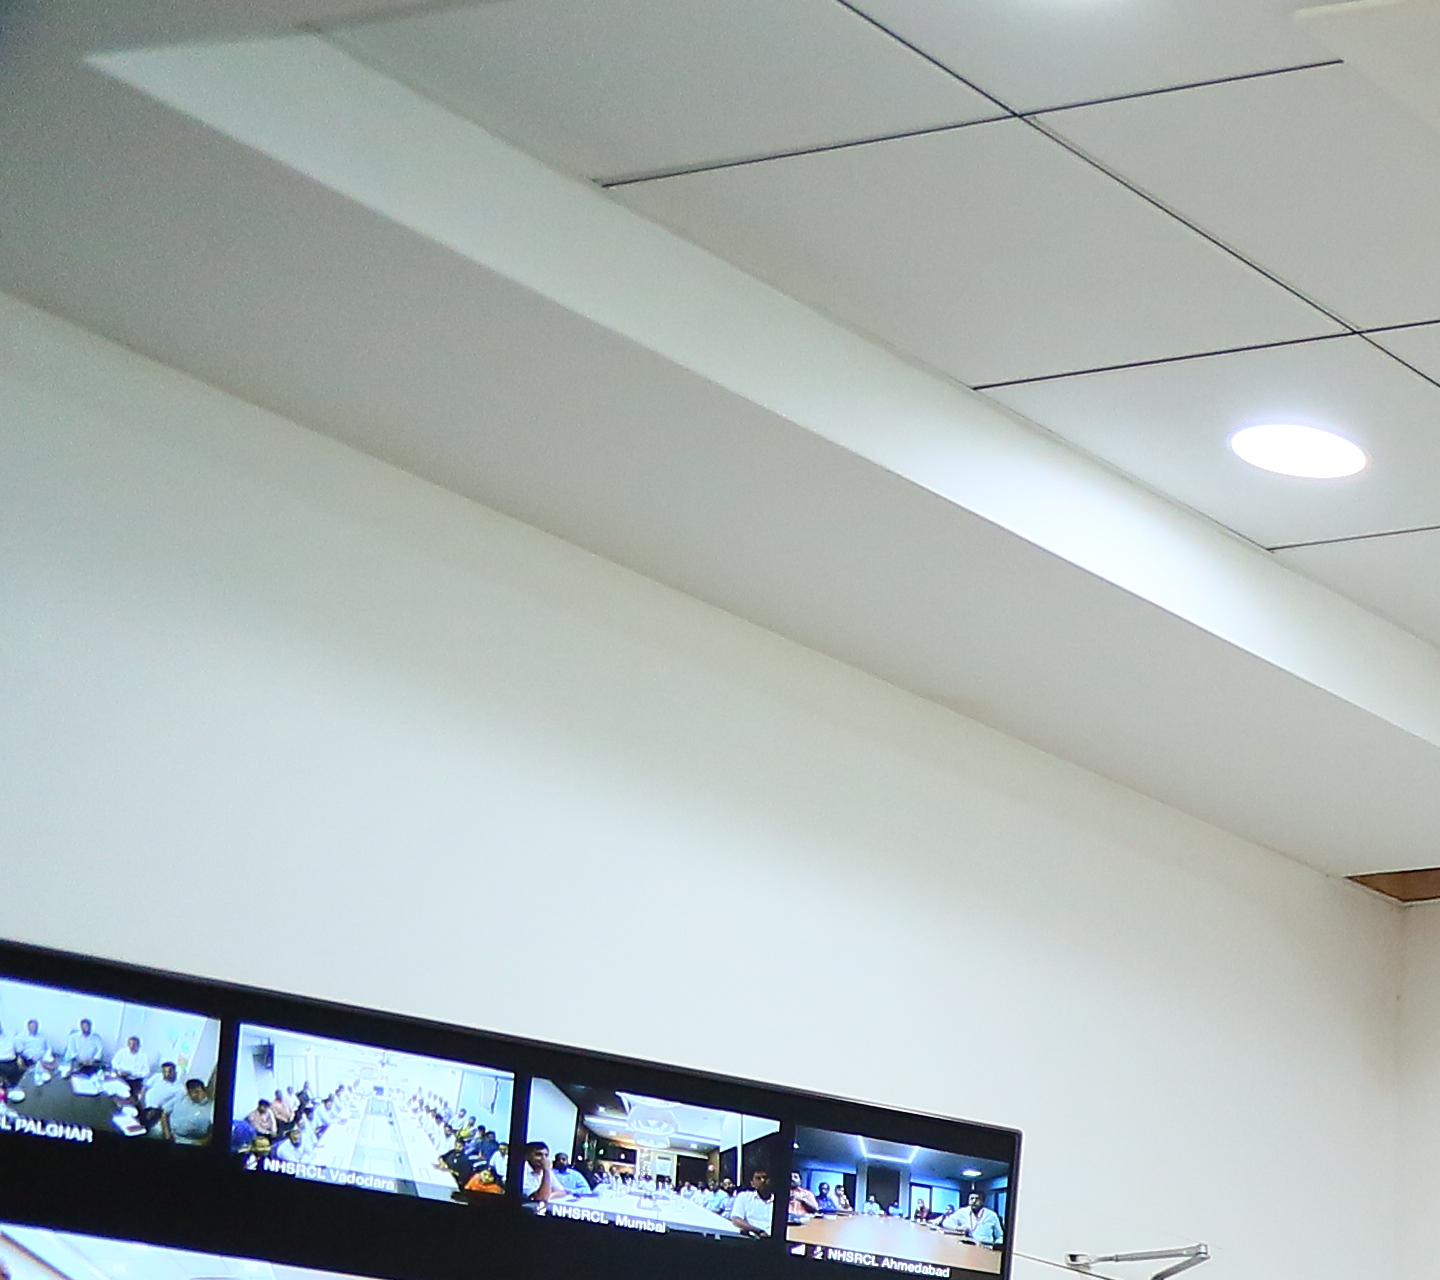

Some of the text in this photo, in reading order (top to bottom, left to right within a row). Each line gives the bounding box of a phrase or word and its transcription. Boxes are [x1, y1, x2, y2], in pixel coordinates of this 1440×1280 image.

[14, 1118, 93, 1143] PALGHAR
[263, 1157, 396, 1191] NHSRCL Vadodara
[552, 1203, 609, 1224] NHSRCL
[827, 1248, 950, 1278] NHSRCL Ahmedabad
